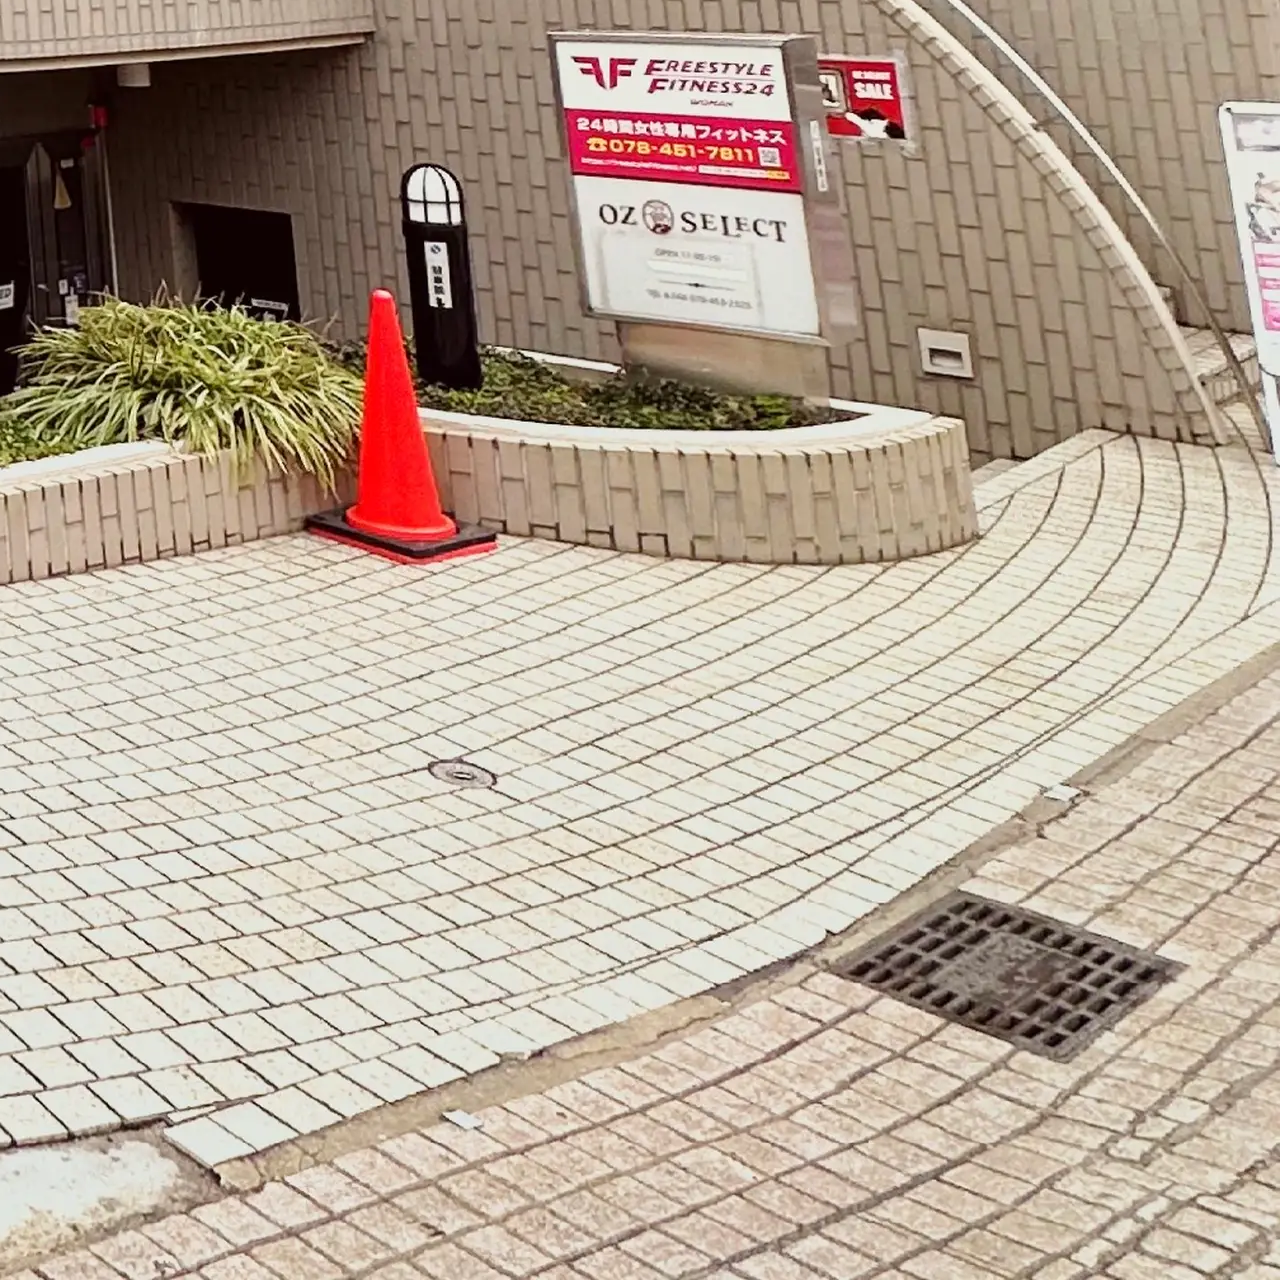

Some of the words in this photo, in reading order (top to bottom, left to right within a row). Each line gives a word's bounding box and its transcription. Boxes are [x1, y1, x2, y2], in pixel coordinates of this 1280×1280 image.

[644, 58, 774, 77] FREESTYLE
[646, 78, 776, 98] FITNESS24
[853, 81, 895, 100] SALE
[598, 203, 639, 226] OZ
[680, 210, 788, 244] SELECT
